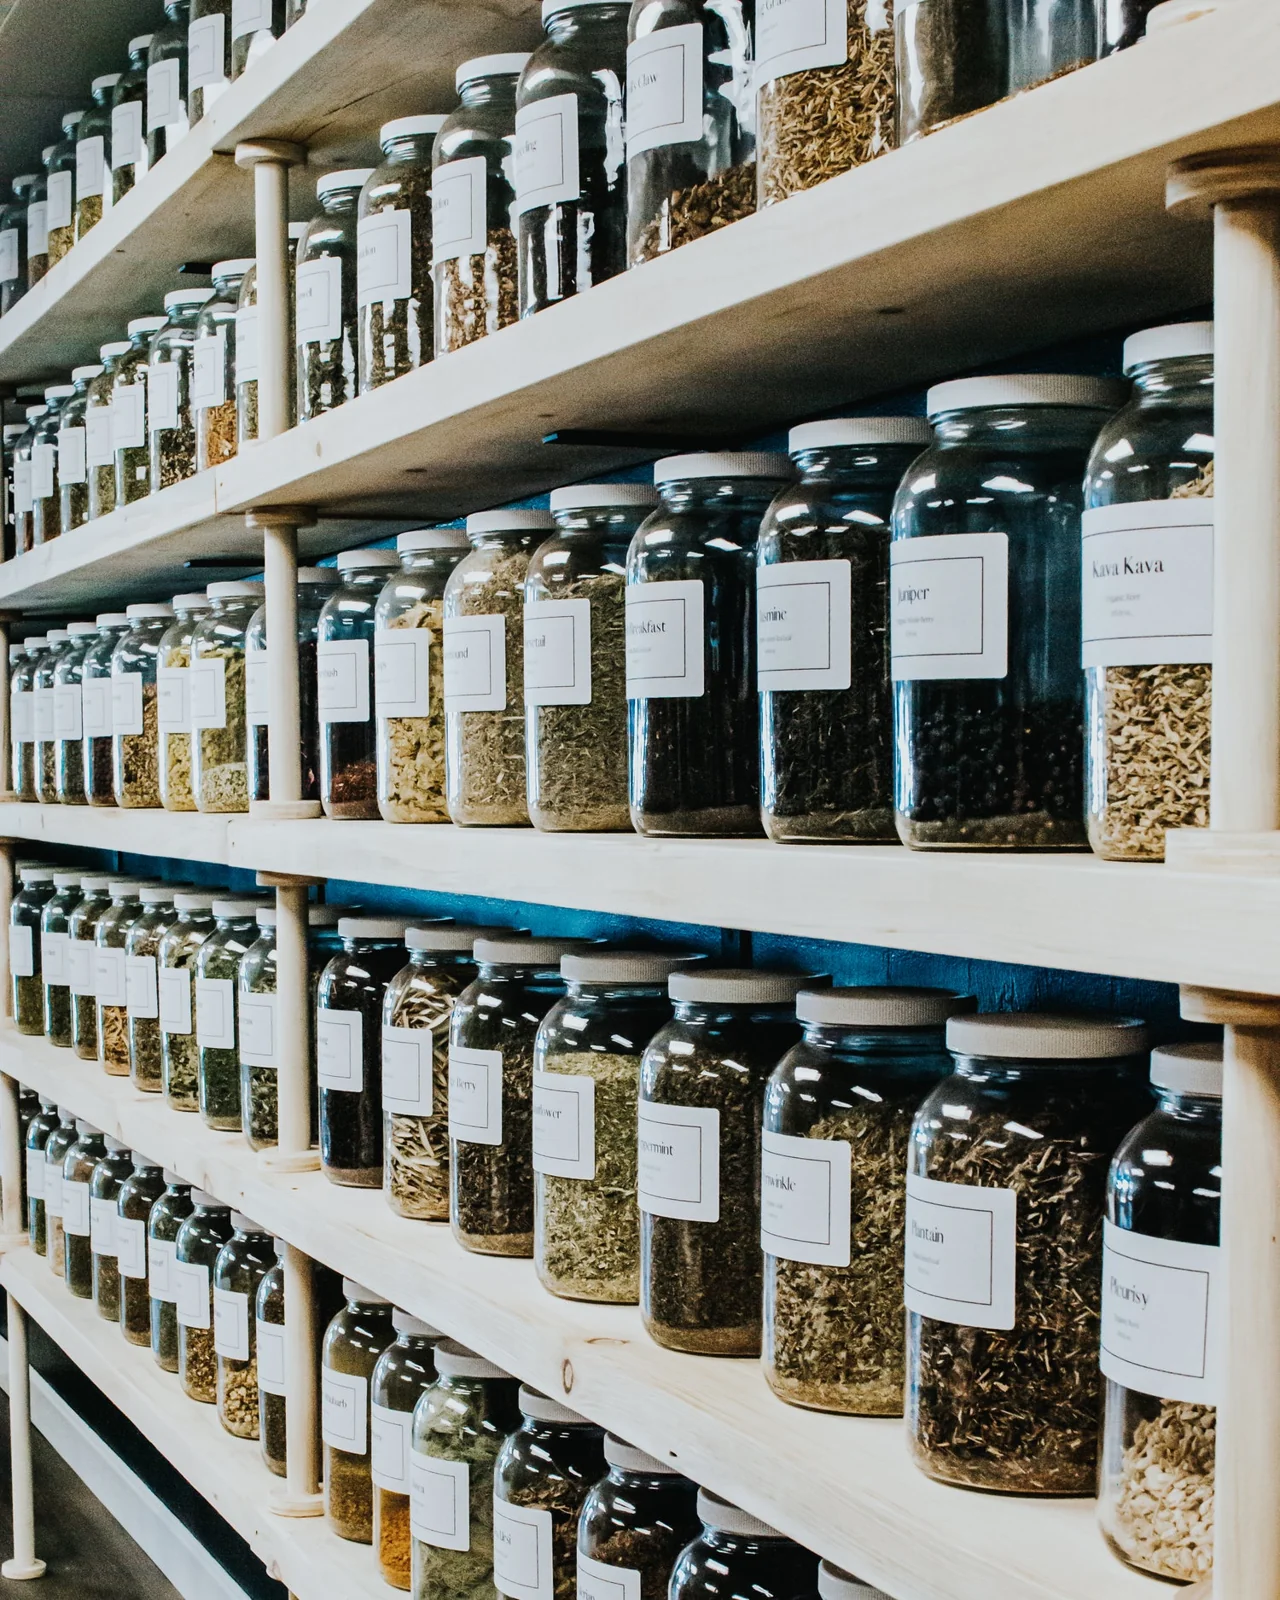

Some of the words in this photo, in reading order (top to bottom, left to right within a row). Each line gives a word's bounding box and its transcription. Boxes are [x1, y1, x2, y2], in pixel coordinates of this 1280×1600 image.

[1092, 560, 1119, 578] Kava
[1123, 556, 1165, 576] Kava
[897, 585, 930, 606] Juniper
[911, 1218, 945, 1245] Plantain
[1110, 1275, 1149, 1311] Pleurisy
